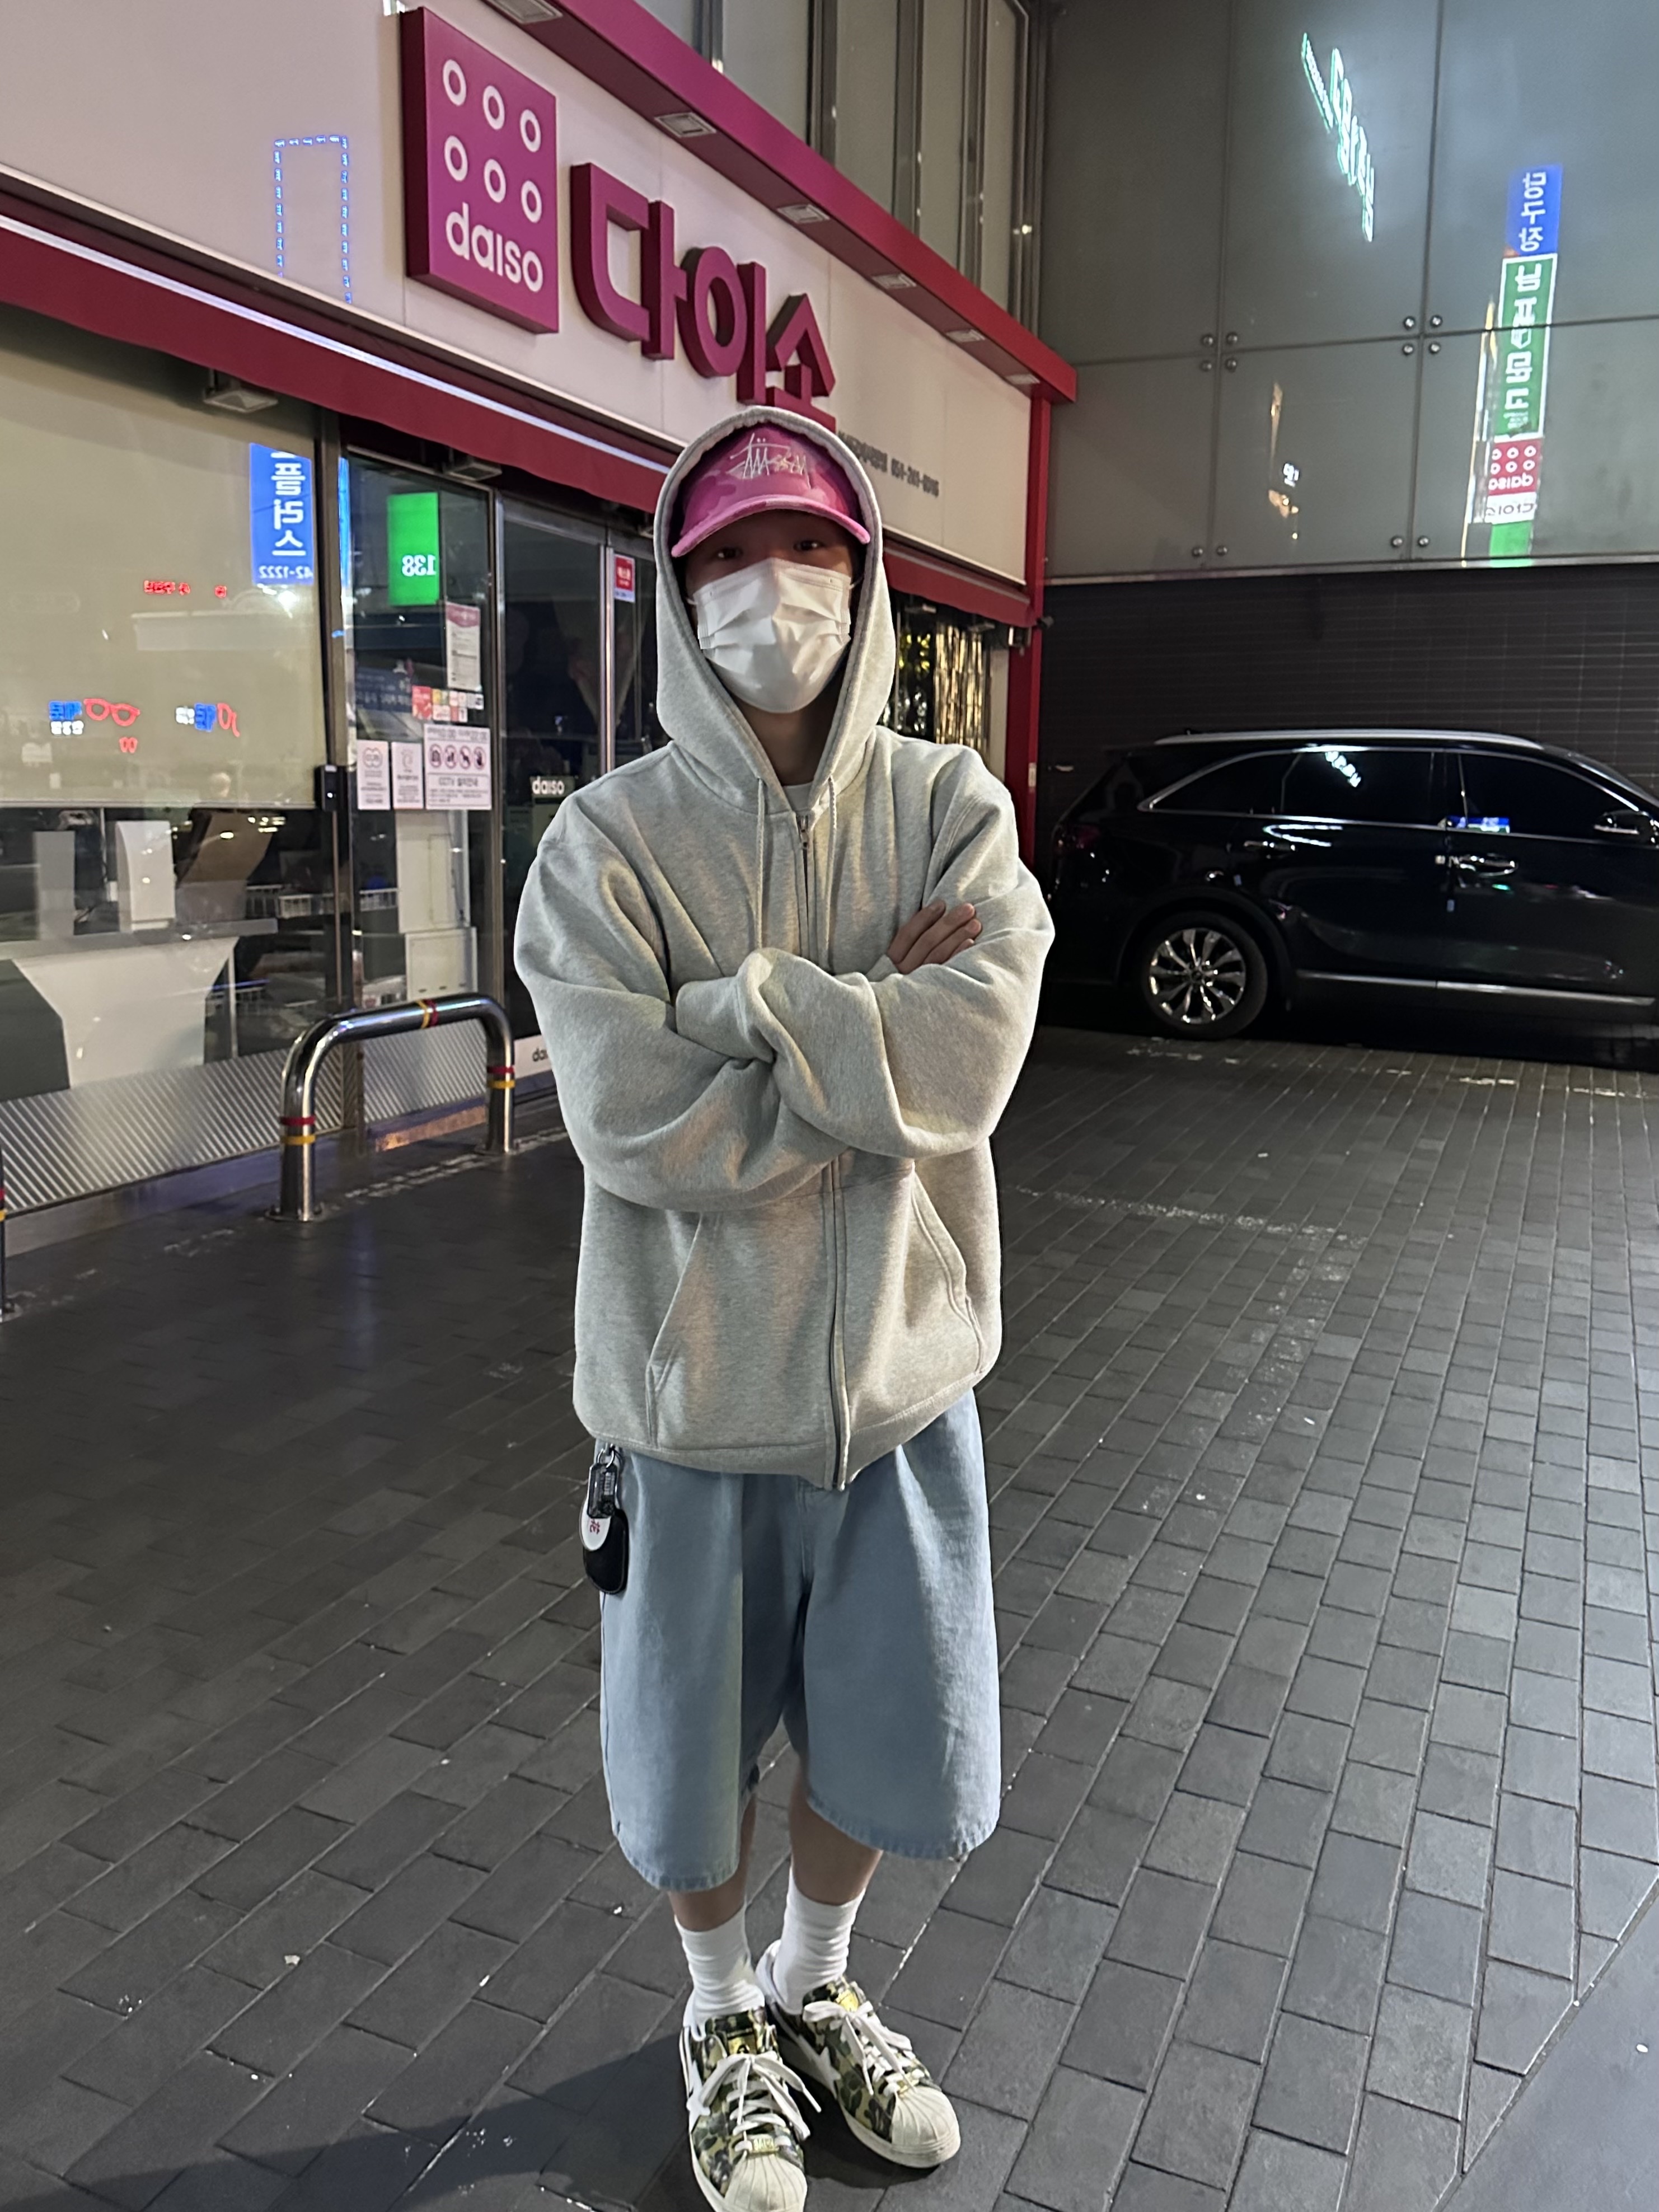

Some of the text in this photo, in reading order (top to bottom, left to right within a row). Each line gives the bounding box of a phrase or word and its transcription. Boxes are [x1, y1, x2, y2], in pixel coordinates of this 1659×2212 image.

[446, 201, 543, 292] daiso
[570, 162, 836, 435] 다이소
[532, 775, 565, 795] daiso
